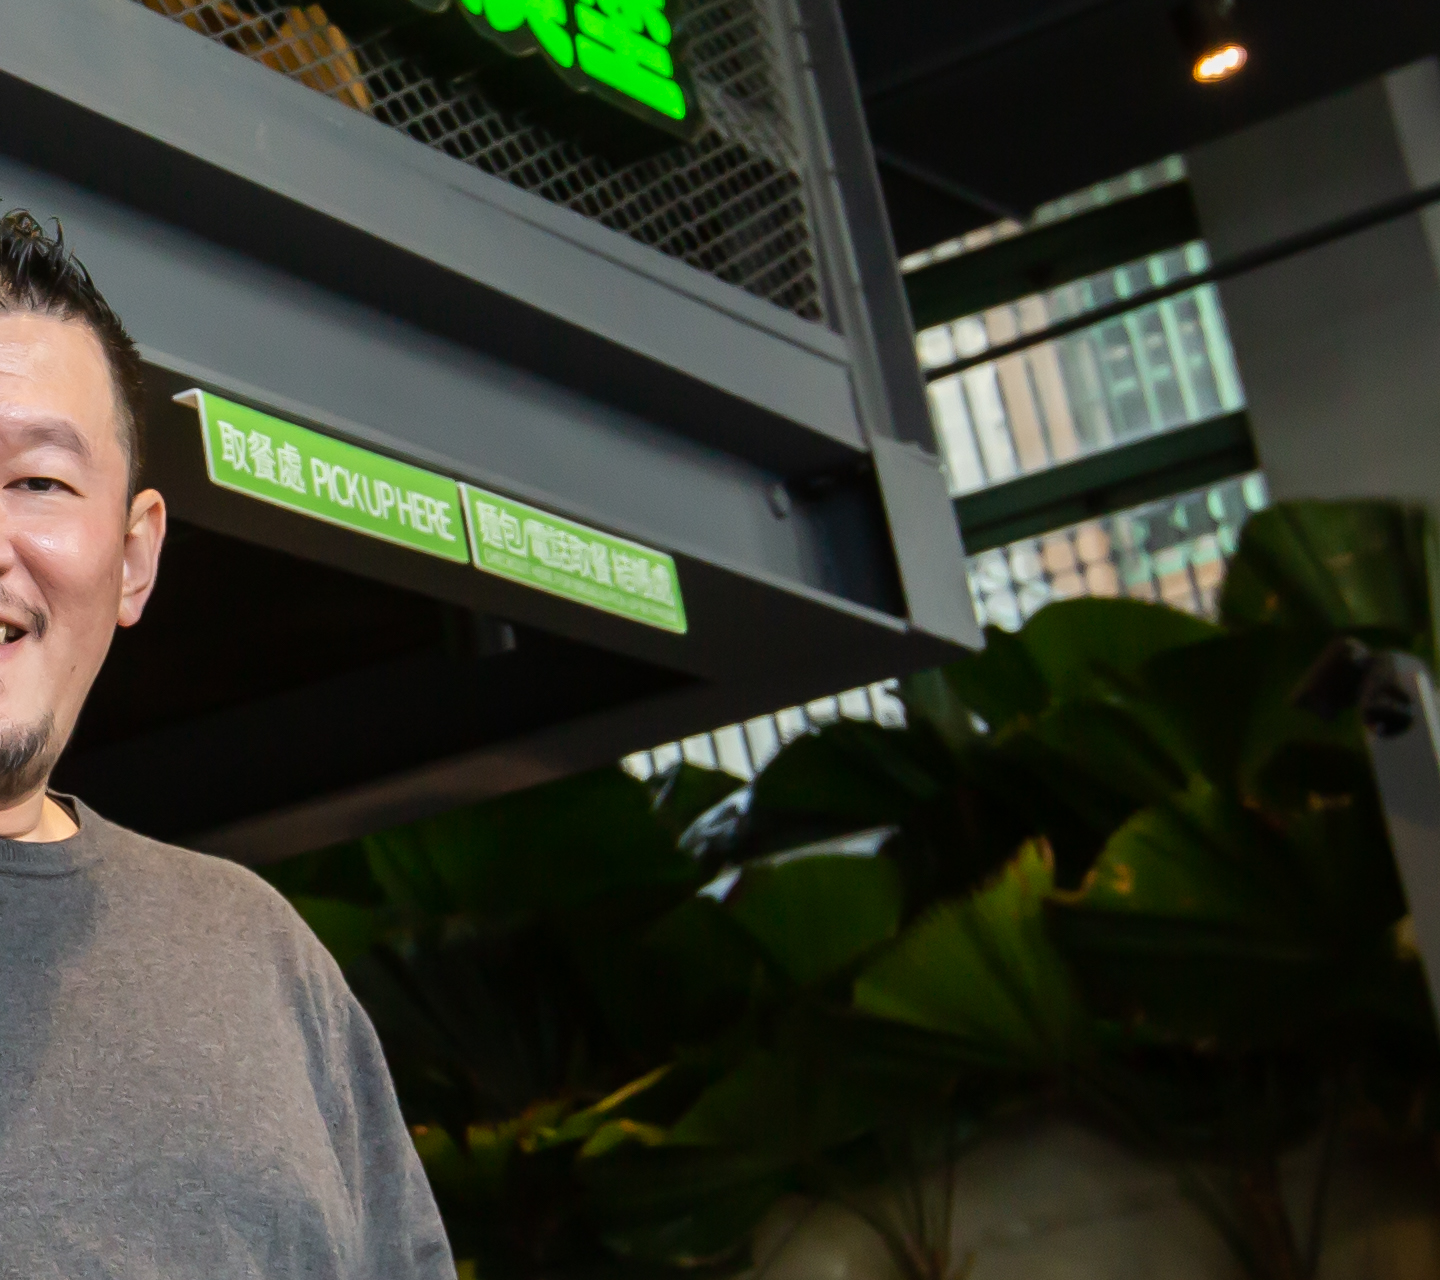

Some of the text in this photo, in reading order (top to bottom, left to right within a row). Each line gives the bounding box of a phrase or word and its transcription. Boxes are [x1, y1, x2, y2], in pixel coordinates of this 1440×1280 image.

[217, 420, 306, 494] 取餐處
[395, 486, 457, 542] HERE
